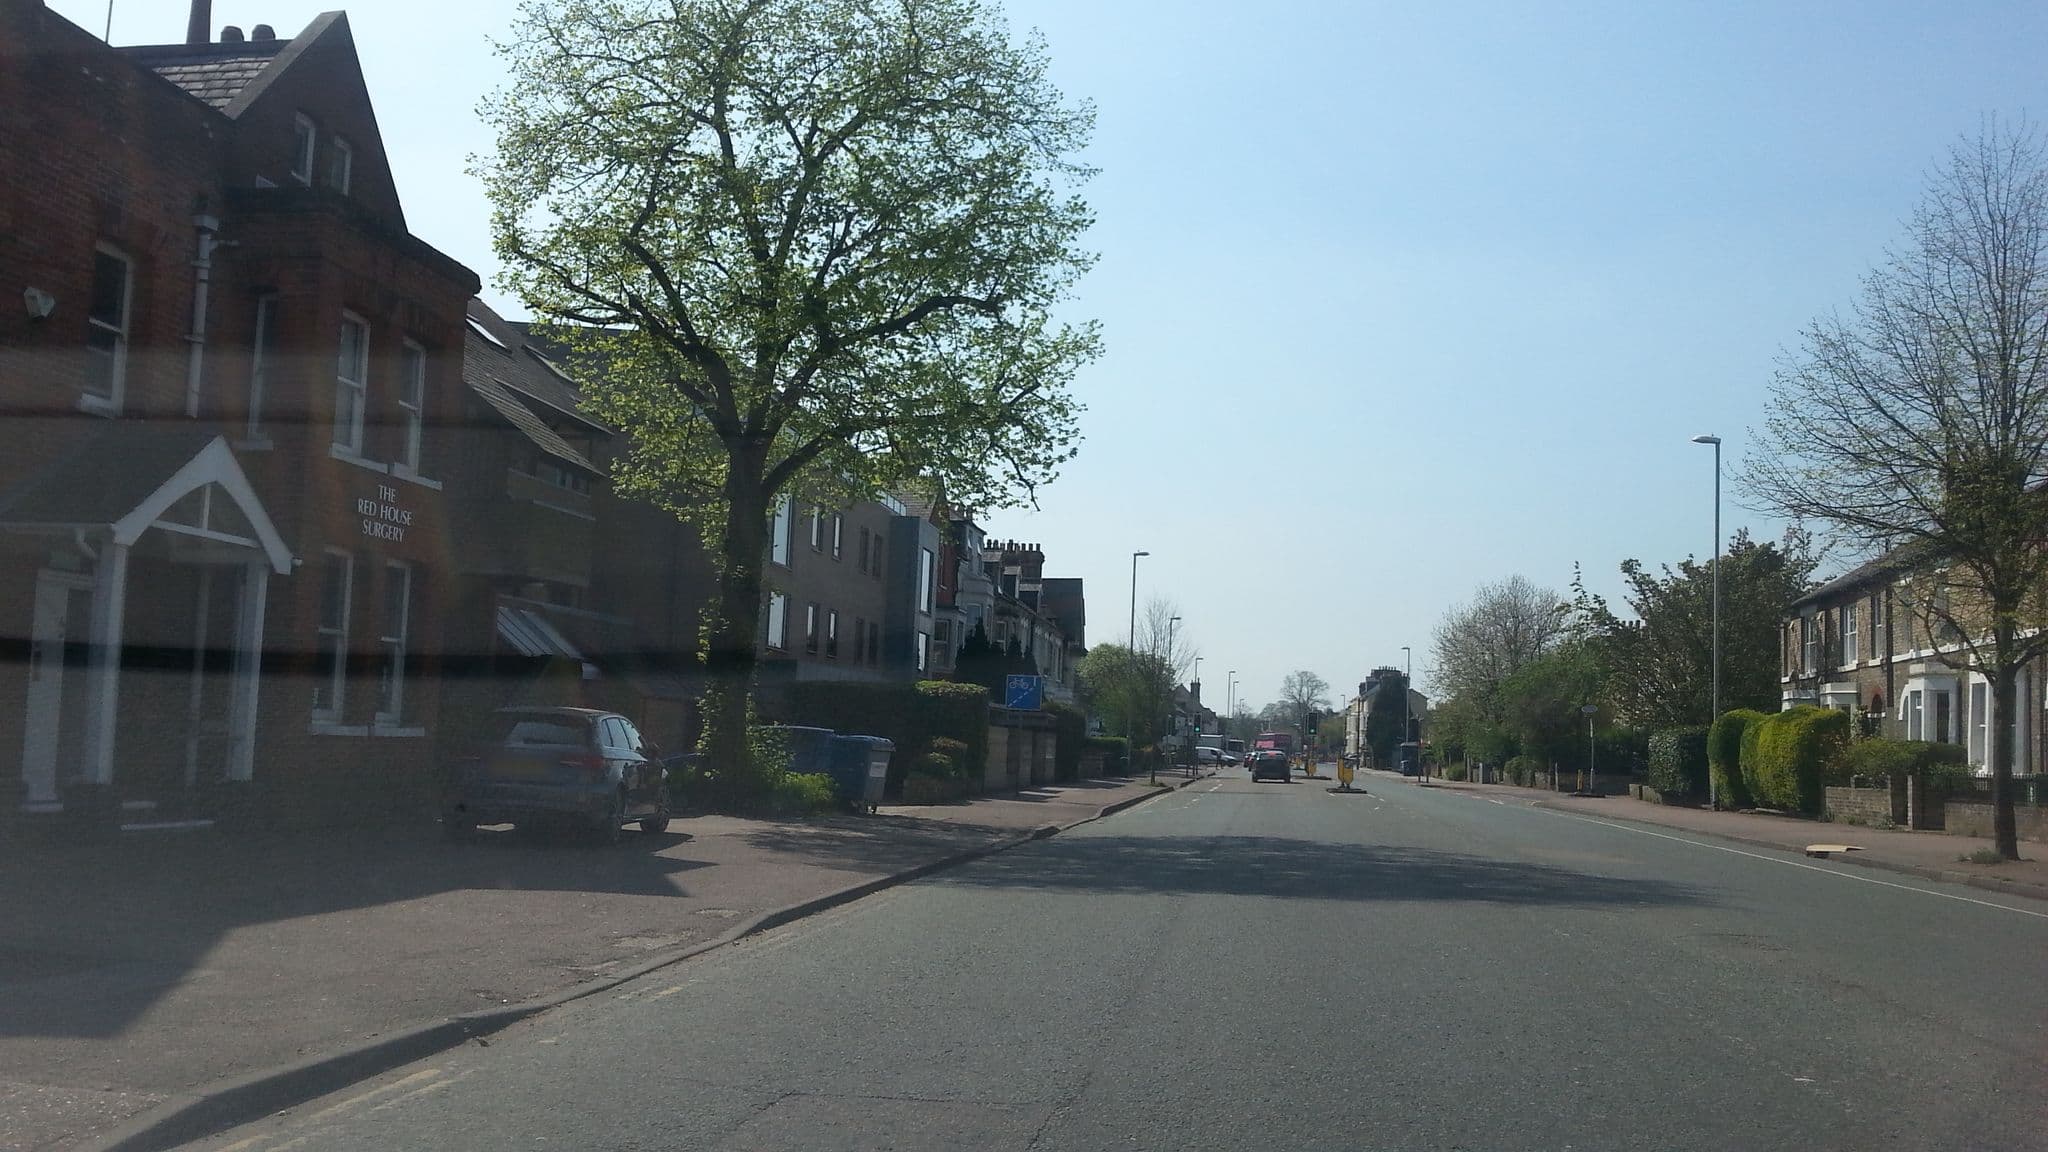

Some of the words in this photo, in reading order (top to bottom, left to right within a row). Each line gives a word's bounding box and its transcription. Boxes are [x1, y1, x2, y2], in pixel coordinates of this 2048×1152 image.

[378, 484, 396, 503] THE
[358, 498, 377, 516] RED
[380, 504, 412, 526] HOUSE
[362, 519, 405, 542] SURGERY
